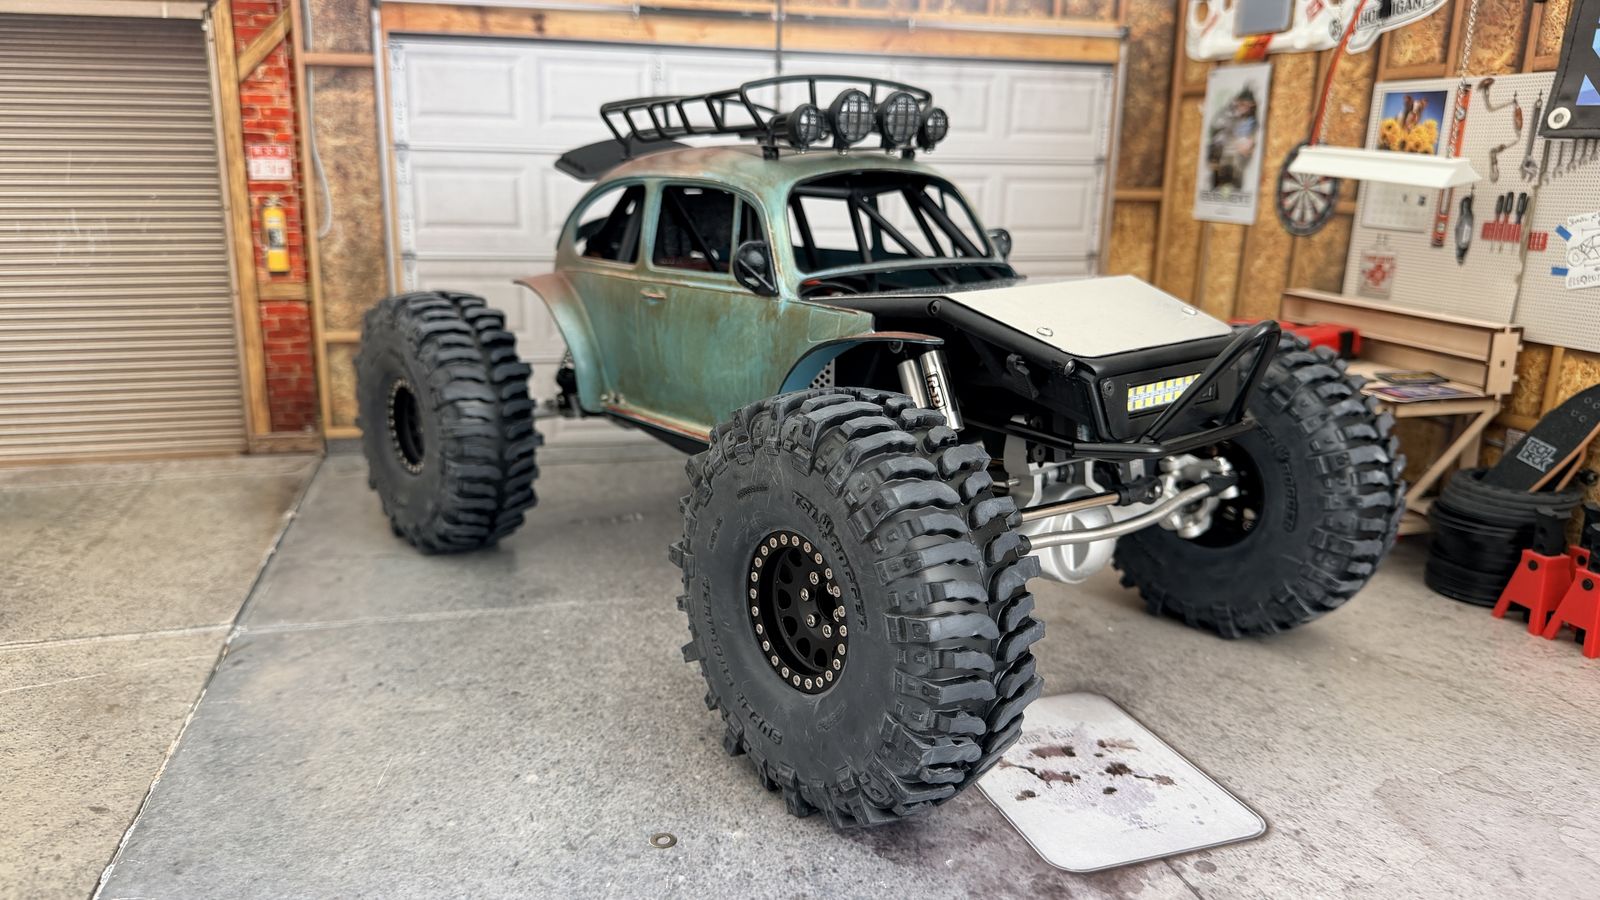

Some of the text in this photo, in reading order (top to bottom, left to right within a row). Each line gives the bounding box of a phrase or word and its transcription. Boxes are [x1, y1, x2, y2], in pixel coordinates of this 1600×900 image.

[1358, 0, 1425, 24] HOIGAN
[1519, 449, 1550, 469] DECK
[1527, 440, 1552, 459] TECH
